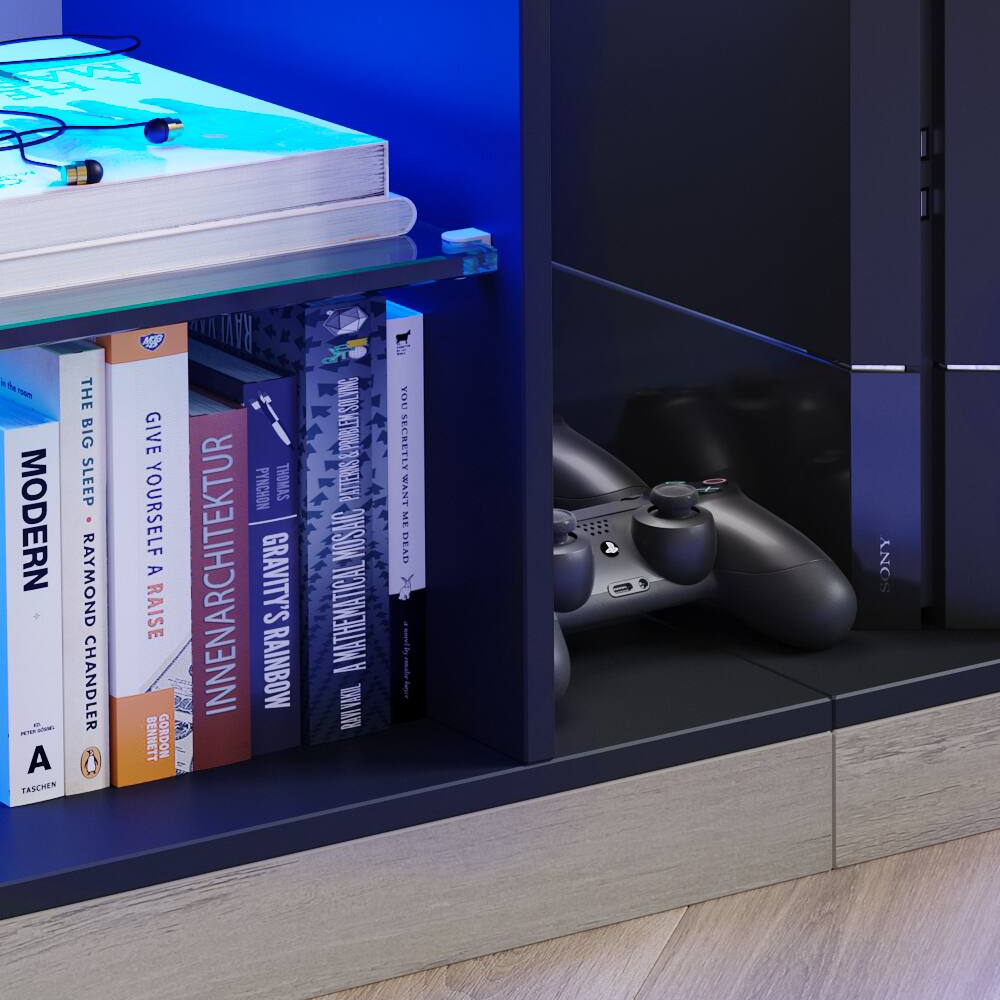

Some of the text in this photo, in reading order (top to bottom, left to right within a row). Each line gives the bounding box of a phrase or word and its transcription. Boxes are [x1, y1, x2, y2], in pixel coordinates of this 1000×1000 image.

[337, 376, 359, 415] SOLVING
[81, 376, 95, 506] THE BIG SLEEP
[338, 411, 360, 453] PROBLEM
[255, 466, 270, 511] PYNCHON
[276, 462, 290, 501] THOMAS
[339, 459, 360, 502] PATTERNS
[400, 385, 410, 565] YOU SECRETLY WANT ME DEAD
[21, 448, 49, 593] MODERN
[145, 411, 165, 641] GIVE YOURSELF A RAISE
[331, 508, 366, 563] MOSAIC
[201, 433, 236, 716] INNENARCHITEKTUR
[879, 535, 891, 593] SONY
[83, 532, 98, 732] RAYMOND CHANDLER
[262, 532, 291, 709] GRAVITY'S RAINBOW
[331, 559, 367, 668] MATHEMATICAL
[20, 729, 37, 737] PETER
[146, 715, 158, 762] BENNETT
[158, 713, 170, 759] GORDON
[340, 706, 362, 730] RAVI
[27, 744, 52, 775] A
[21, 781, 57, 795] TASCHEN
